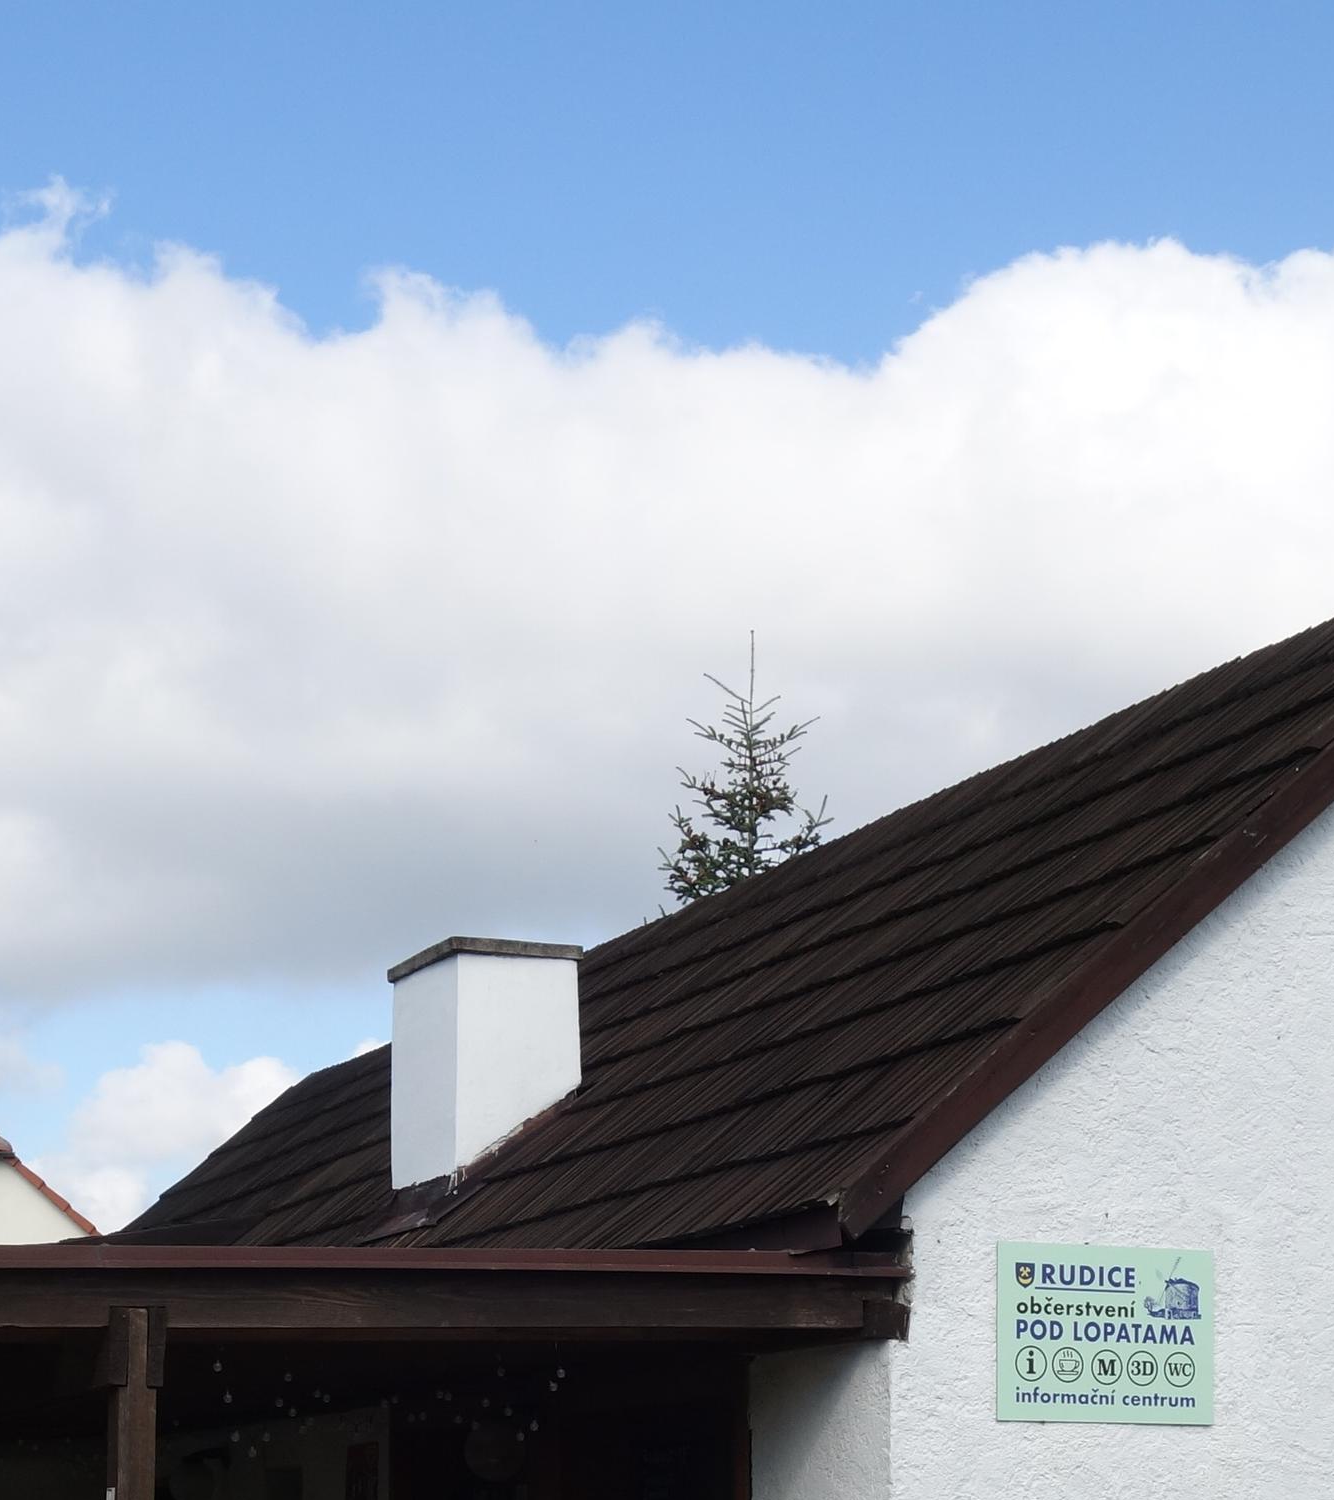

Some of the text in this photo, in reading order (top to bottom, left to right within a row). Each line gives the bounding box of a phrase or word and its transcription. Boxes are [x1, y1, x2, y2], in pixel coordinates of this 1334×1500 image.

[1041, 1263, 1136, 1288] RUDICE
[1016, 1296, 1136, 1318] občerstvení
[1015, 1319, 1195, 1345] POD LOPATAMA
[1097, 1358, 1117, 1376] M
[1130, 1360, 1155, 1377] 3D
[1168, 1362, 1192, 1377] WC
[1015, 1386, 1196, 1408] informační centrum
